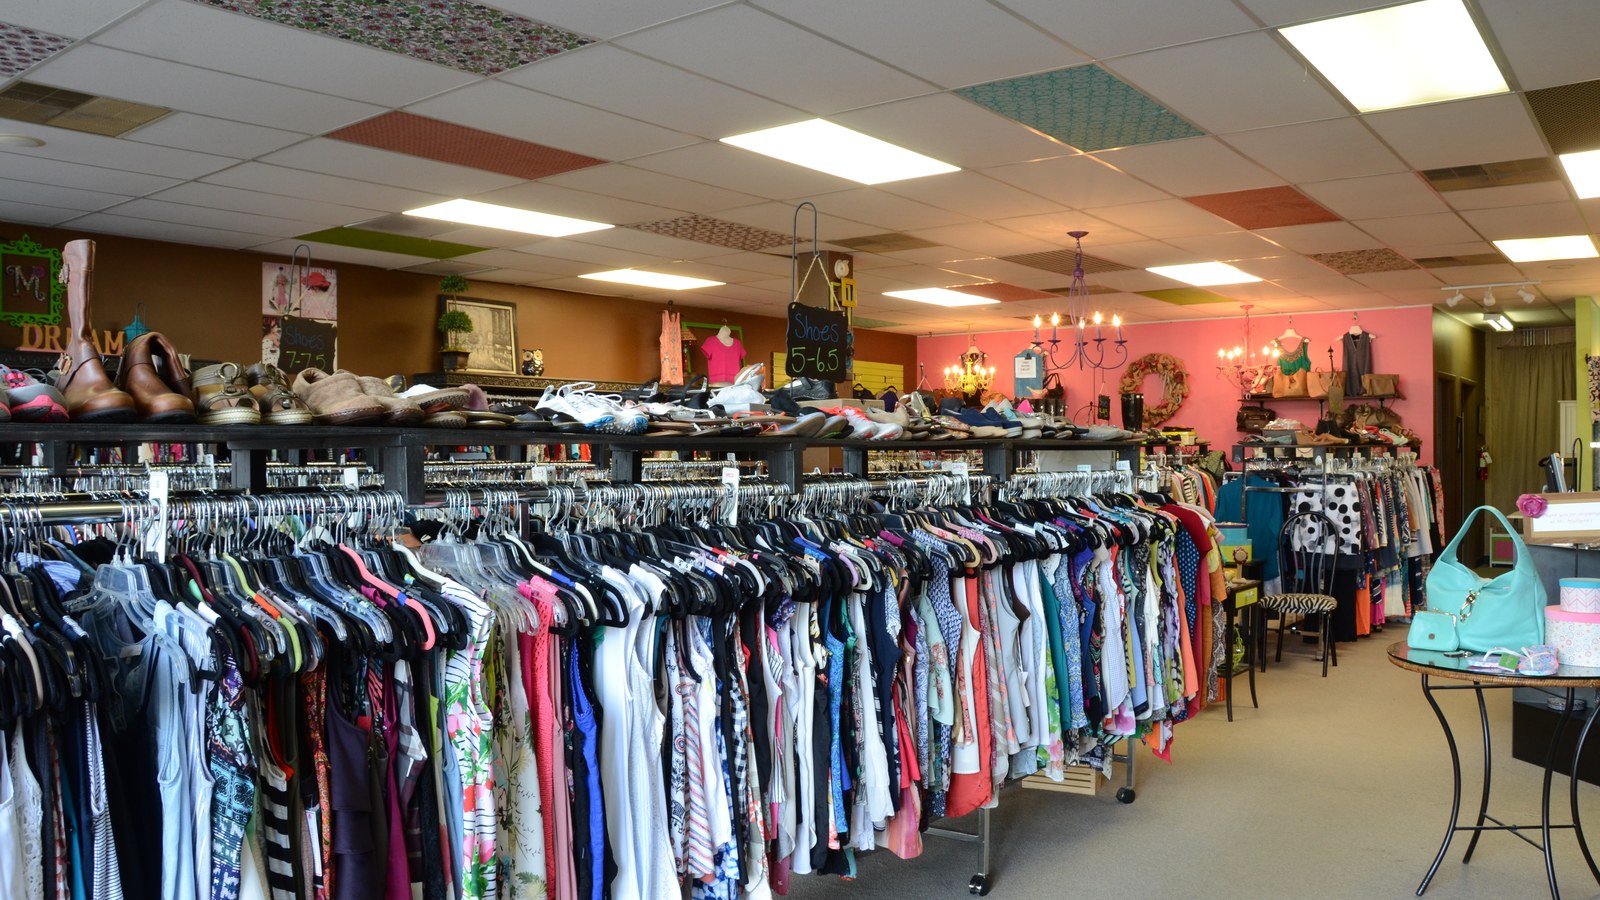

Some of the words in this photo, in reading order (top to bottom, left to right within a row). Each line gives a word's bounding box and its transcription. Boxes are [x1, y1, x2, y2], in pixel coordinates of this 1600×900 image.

[6, 264, 46, 301] M
[21, 322, 125, 355] DRAM
[285, 325, 325, 350] Shoes
[795, 313, 840, 343] Shoes
[792, 347, 839, 373] 5-6.5
